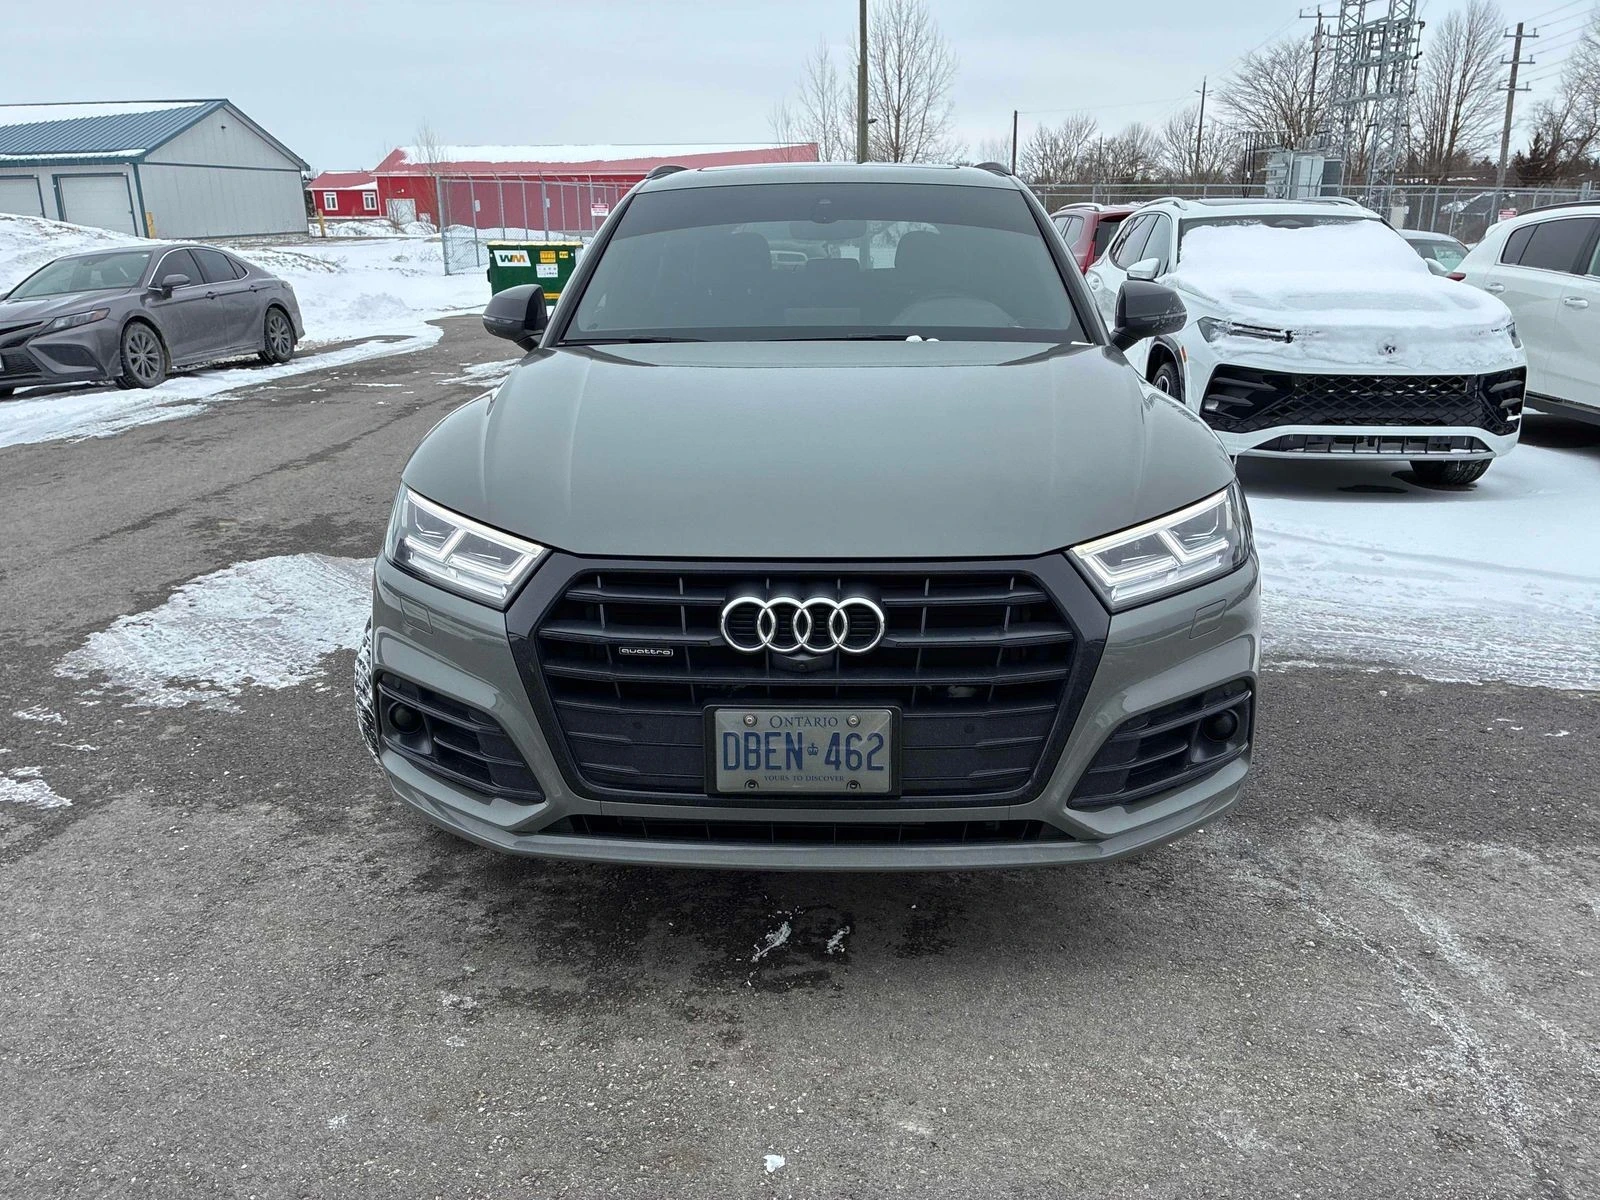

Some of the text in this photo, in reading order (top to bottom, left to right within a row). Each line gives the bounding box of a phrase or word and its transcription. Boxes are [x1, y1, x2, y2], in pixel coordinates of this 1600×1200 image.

[499, 254, 526, 262] WM
[723, 731, 884, 771] DBEN 462
